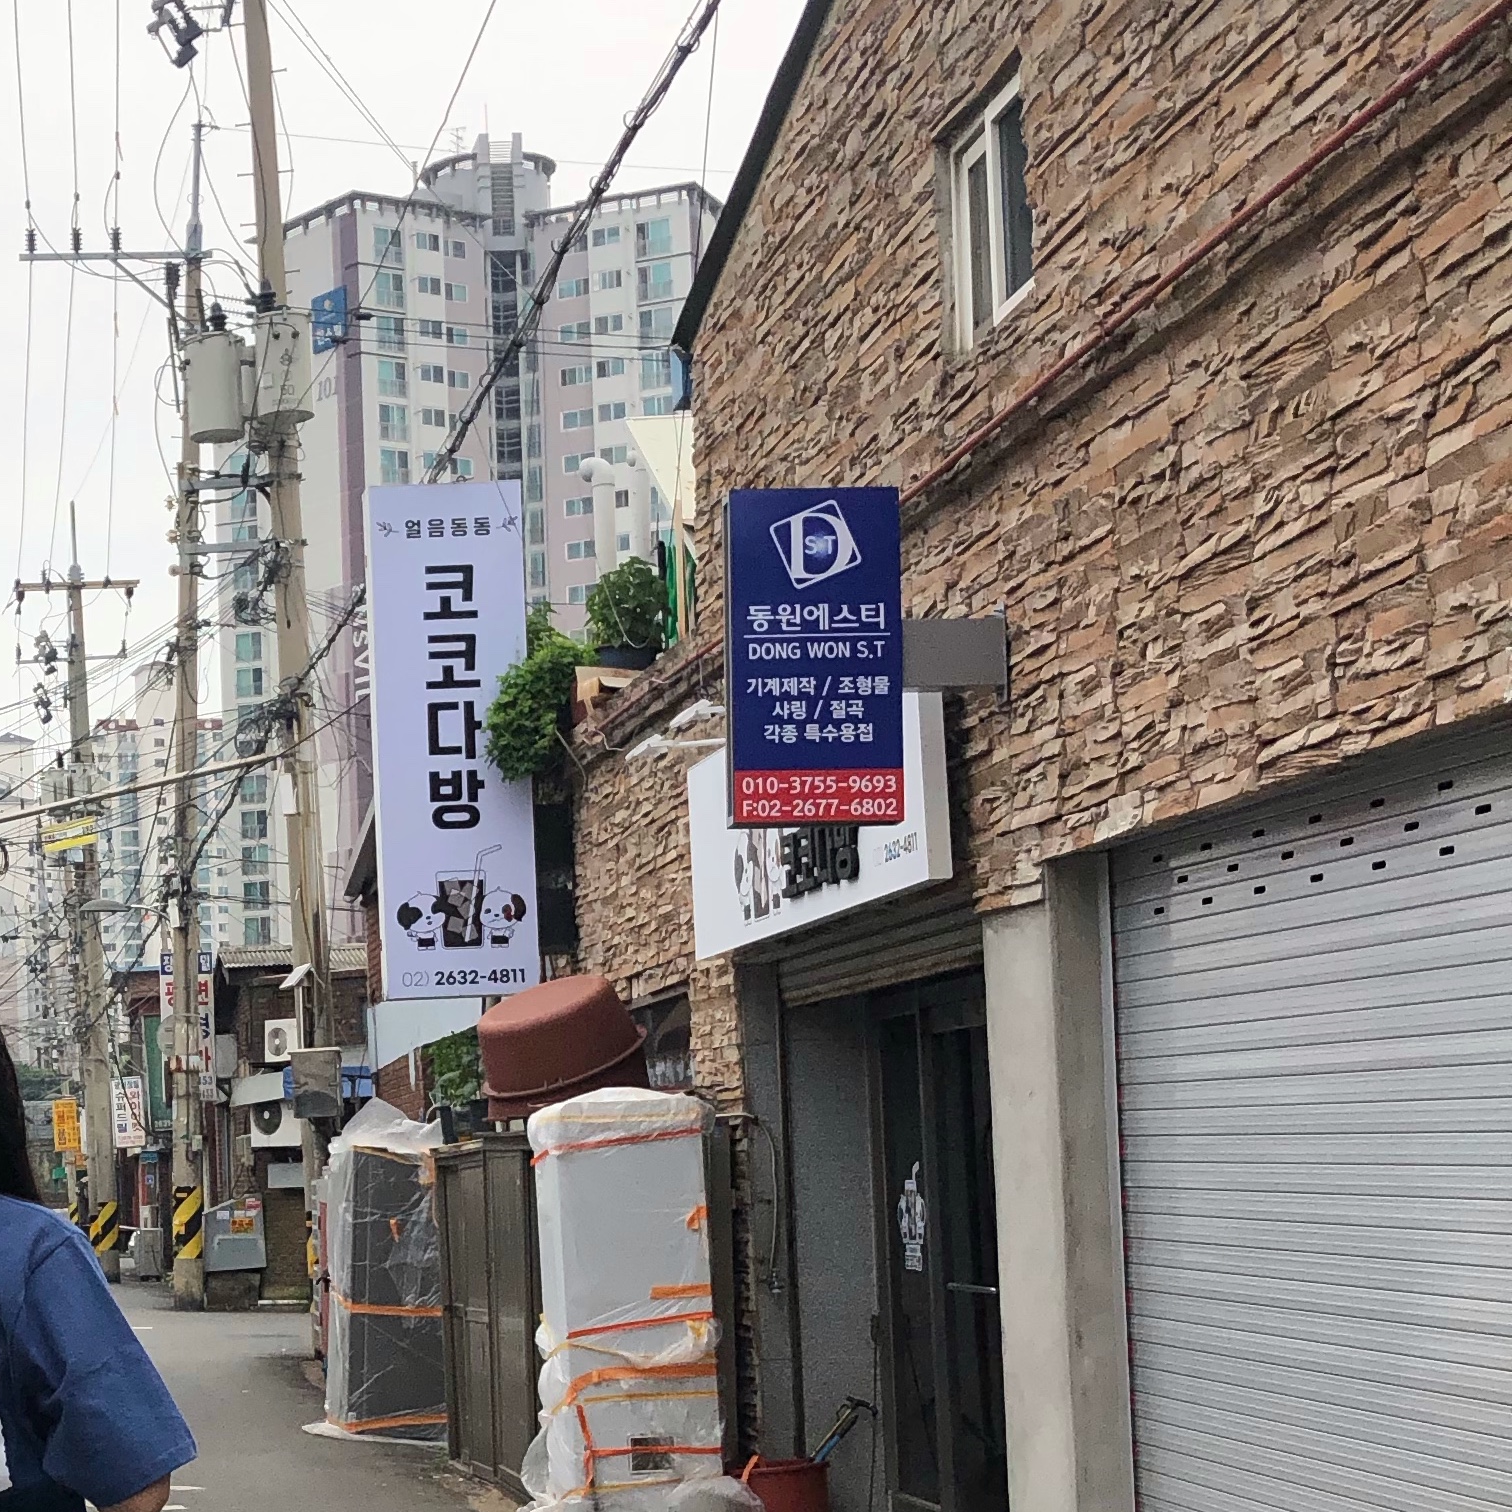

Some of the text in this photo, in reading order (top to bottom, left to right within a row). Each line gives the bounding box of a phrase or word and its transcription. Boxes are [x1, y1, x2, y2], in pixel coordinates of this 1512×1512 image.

[405, 516, 491, 539] 얼음동동
[746, 602, 885, 632] 동원에스티
[748, 640, 885, 660] DONG WON S.T
[746, 675, 890, 697] 기계제작 / 조형물
[423, 564, 485, 829] 코코다방
[772, 699, 864, 720] 샤링 / 절곡
[764, 723, 873, 743] 각종 특수용접
[742, 775, 897, 795] 010-3755-9693
[742, 798, 898, 817] F:02-2677-6802
[434, 968, 526, 986] 2632-4811
